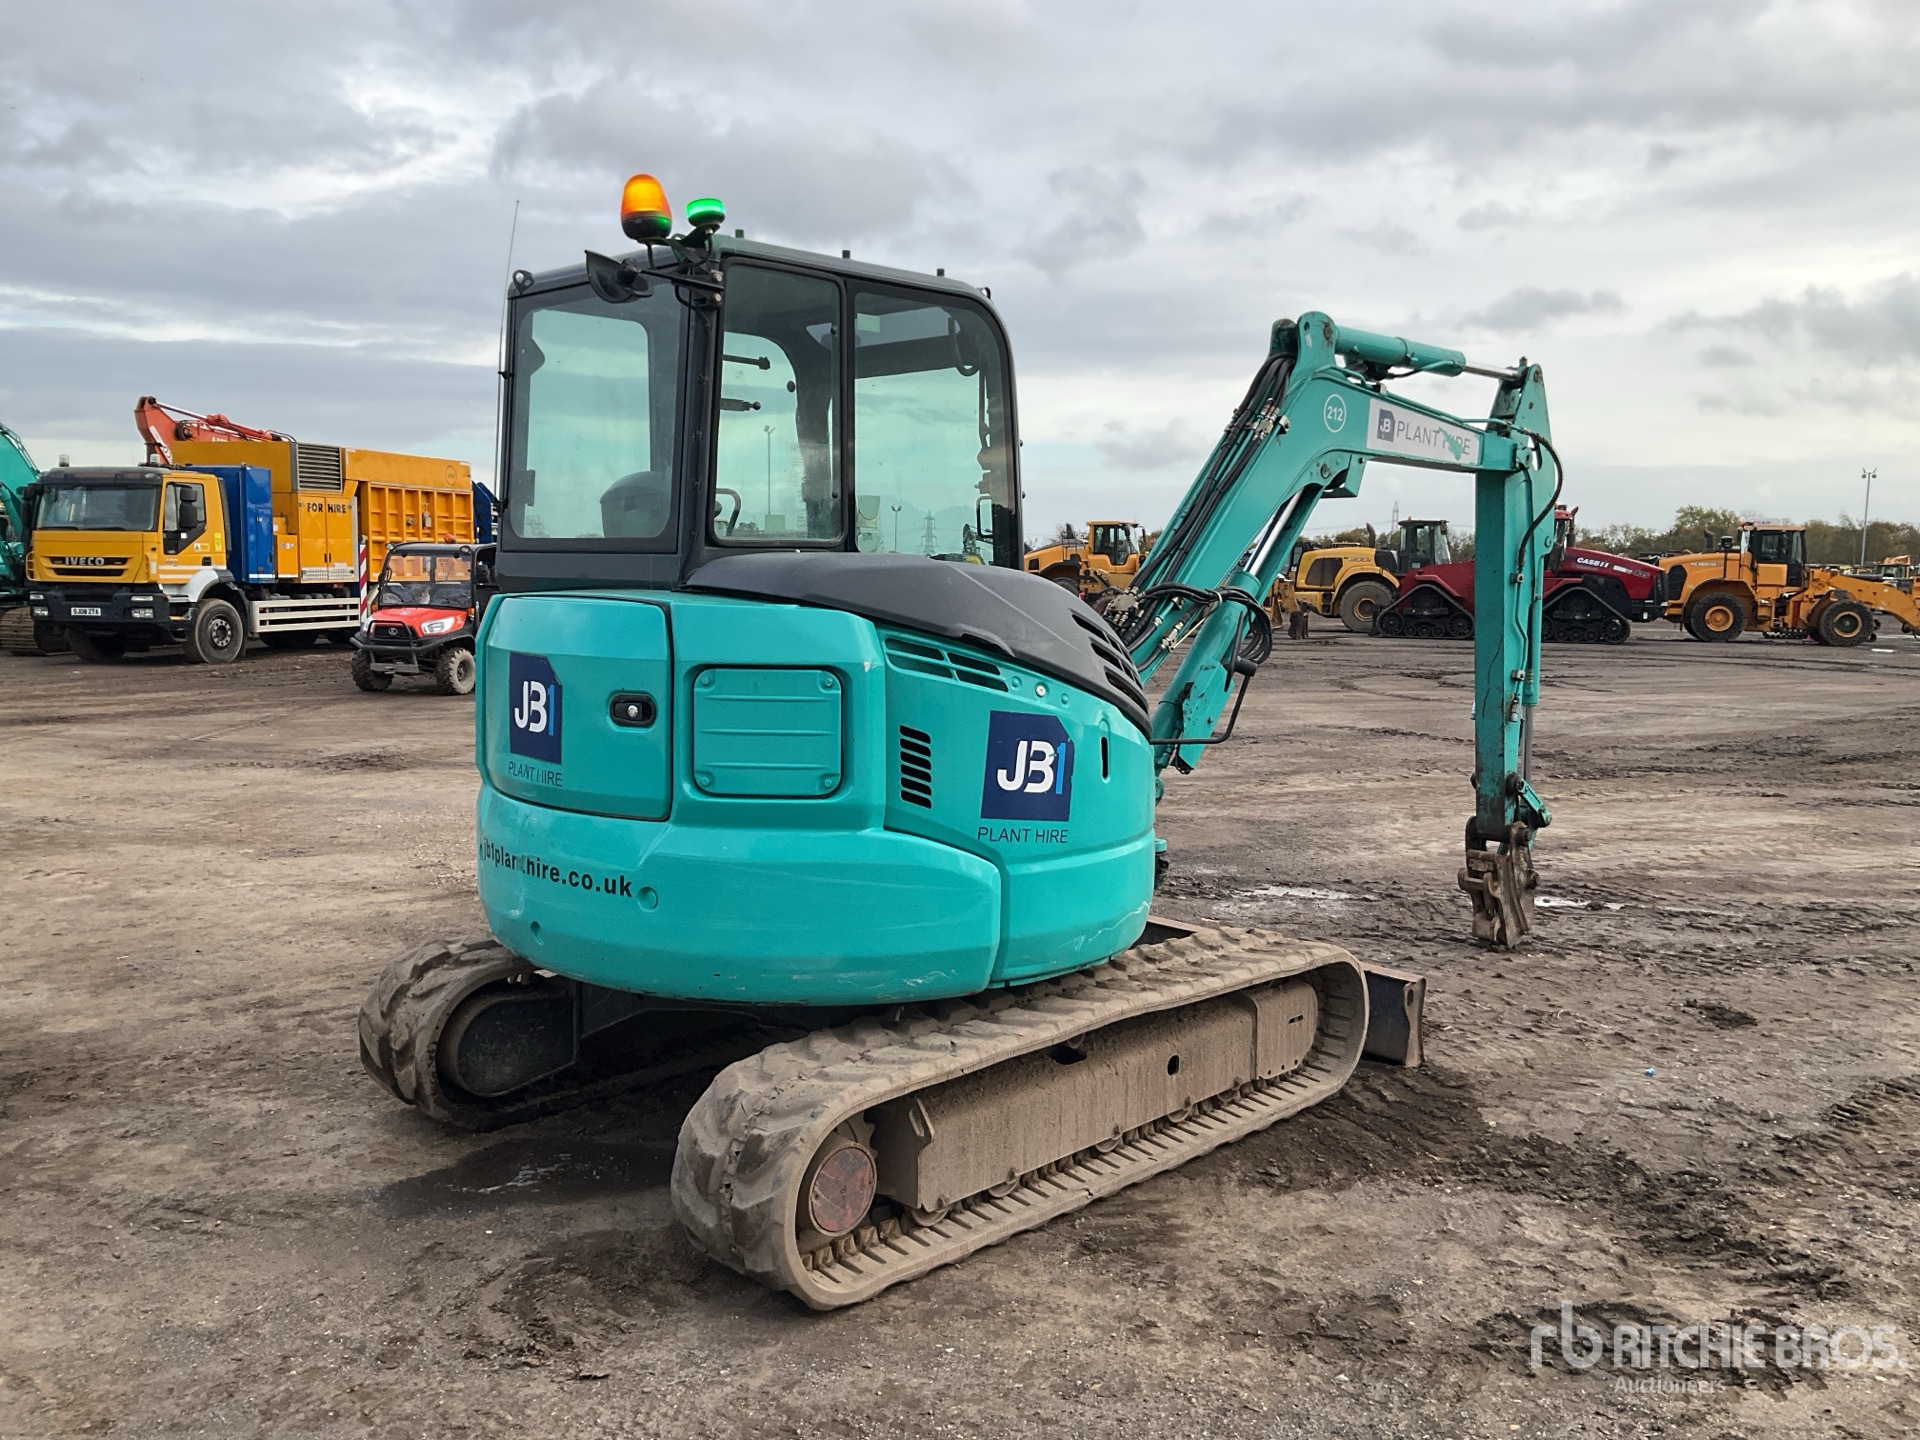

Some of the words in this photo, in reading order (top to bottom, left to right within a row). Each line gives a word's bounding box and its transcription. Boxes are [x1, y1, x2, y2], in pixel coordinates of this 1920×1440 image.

[1326, 405, 1344, 422] 212
[1396, 420, 1440, 448] PLANT
[1442, 430, 1471, 456] RE
[307, 503, 324, 512] FOR
[327, 504, 347, 514] HIRE
[65, 556, 105, 567] IVECO
[1576, 557, 1600, 567] CASE
[514, 680, 555, 736] JB1
[508, 760, 536, 780] PLANT
[536, 769, 563, 787] HIRE
[997, 740, 1067, 795] JB1
[977, 826, 1032, 843] PLANT
[1034, 829, 1069, 844] HIRE
[484, 838, 633, 898] jb1plahire.co.uk
